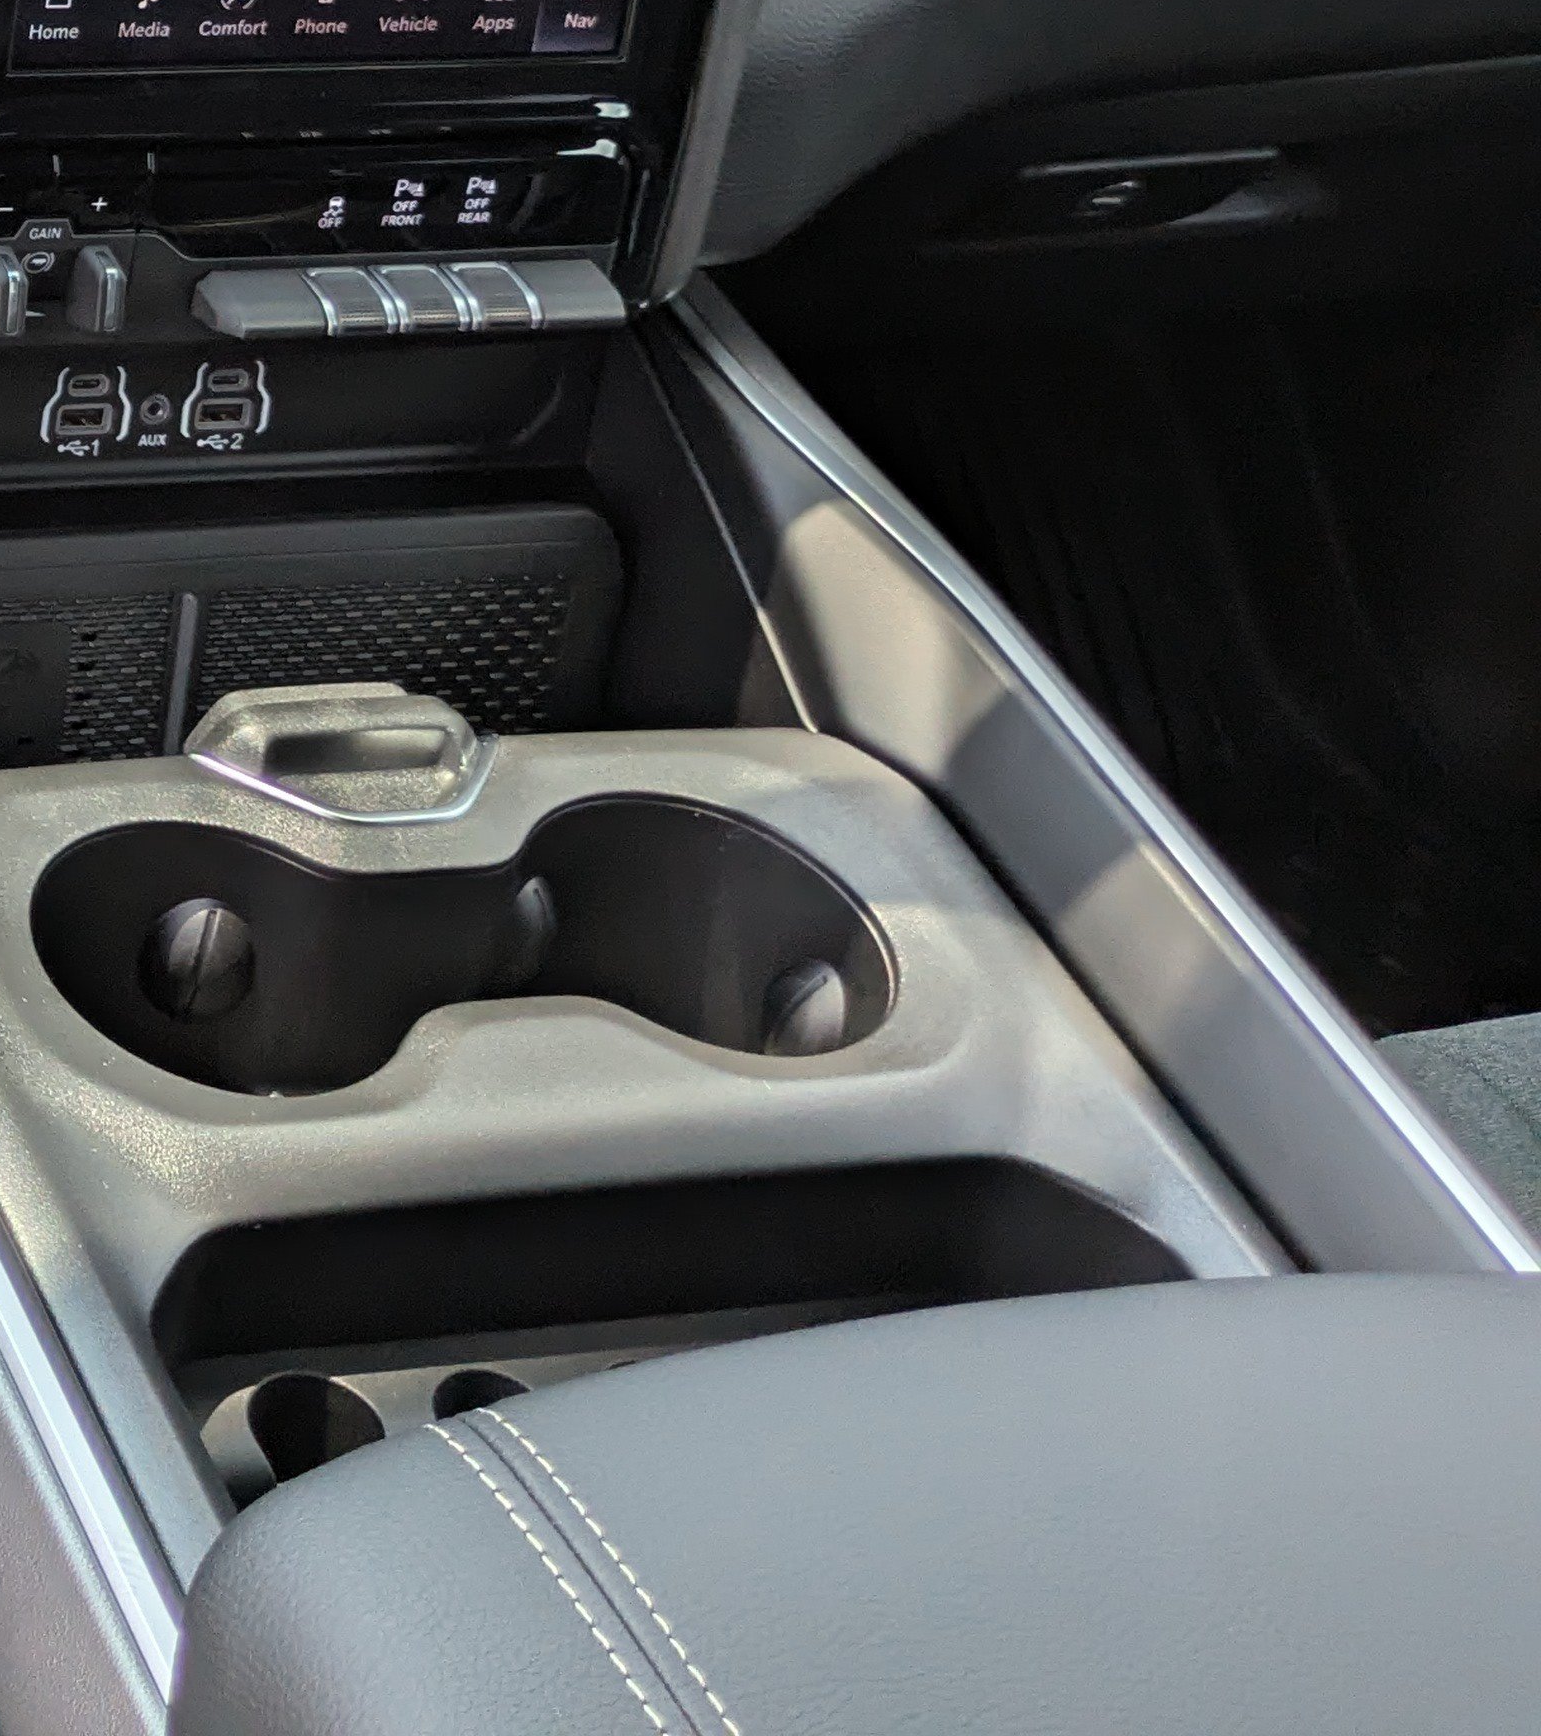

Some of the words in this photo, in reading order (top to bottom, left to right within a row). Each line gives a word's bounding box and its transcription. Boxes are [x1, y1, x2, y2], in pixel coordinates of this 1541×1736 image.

[118, 21, 171, 37] Media
[199, 19, 267, 36] Comfort
[295, 18, 347, 34] Phone
[378, 16, 438, 32] Vehicle
[471, 15, 514, 34] Apps
[564, 13, 598, 29] Nav
[29, 24, 79, 40] Home
[393, 201, 418, 213] OFF
[465, 198, 490, 210] OFF
[318, 217, 343, 229] OFF
[380, 214, 425, 227] FRONT
[457, 212, 491, 224] REAR
[29, 227, 61, 240] GAIN
[90, 439, 100, 456] 1
[138, 434, 166, 446] AUX
[231, 433, 244, 449] 2
